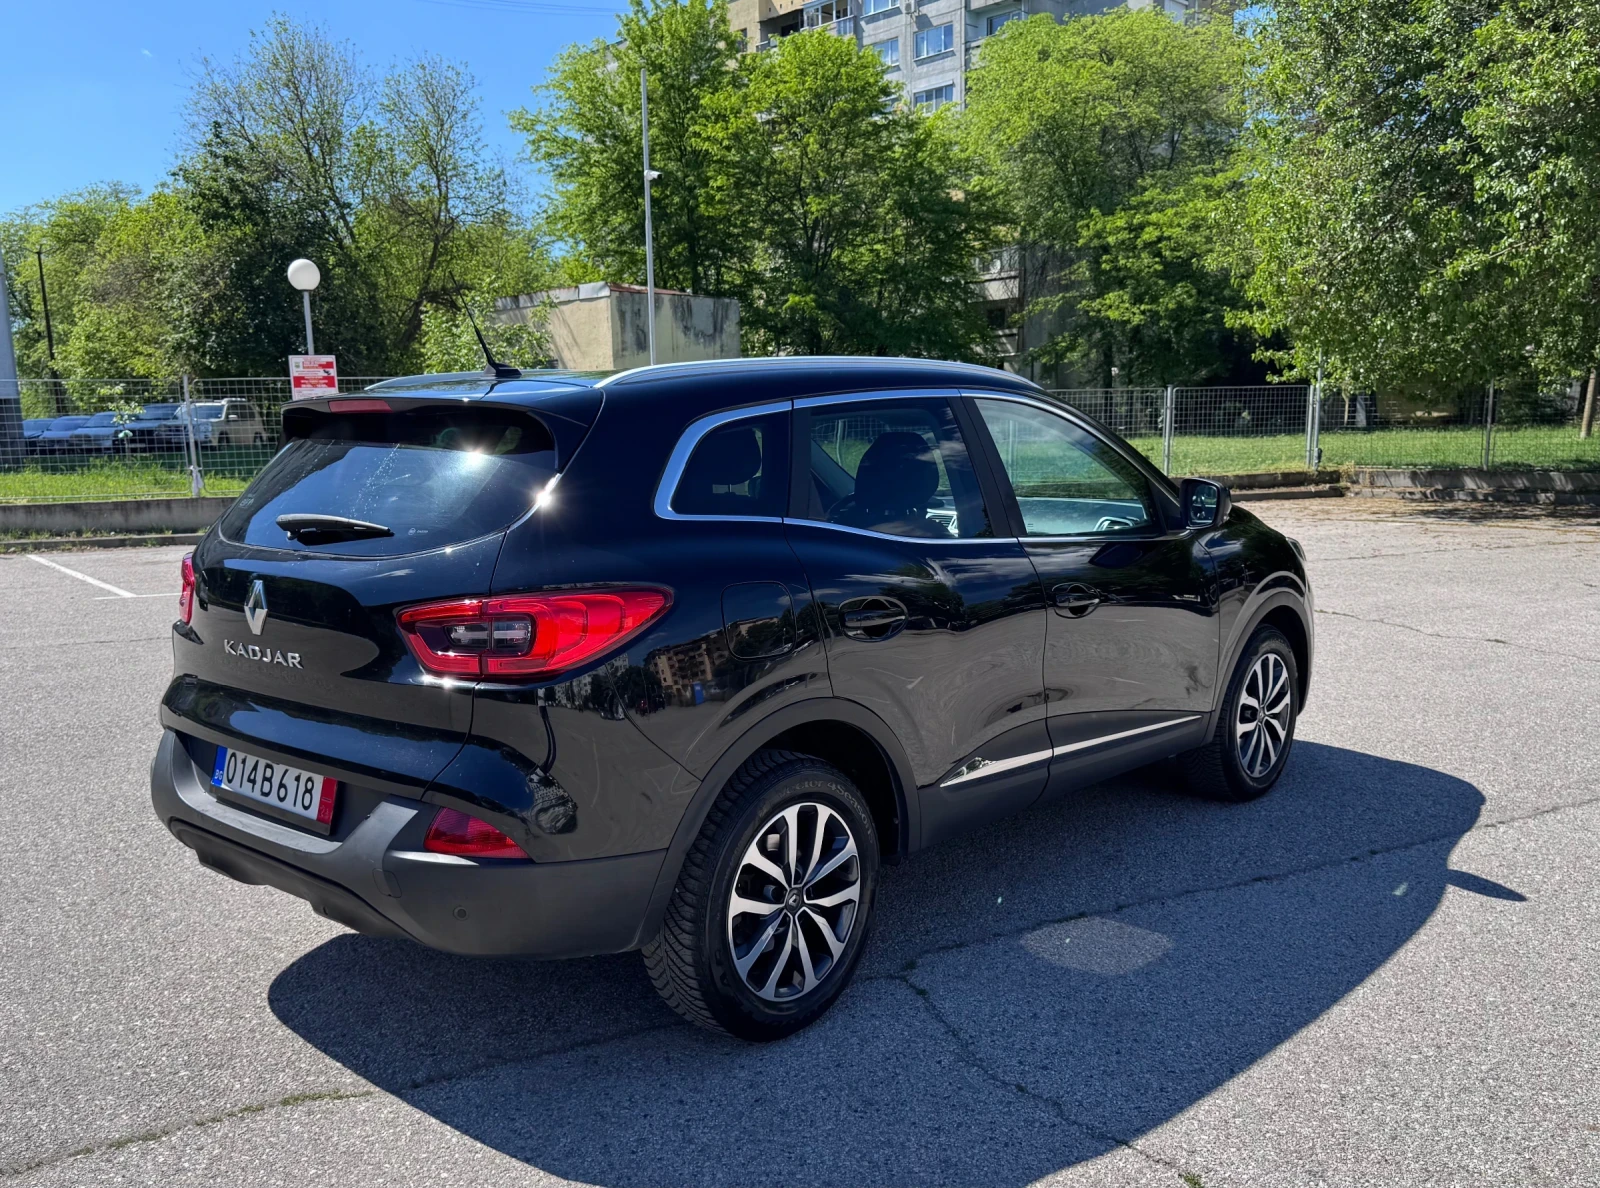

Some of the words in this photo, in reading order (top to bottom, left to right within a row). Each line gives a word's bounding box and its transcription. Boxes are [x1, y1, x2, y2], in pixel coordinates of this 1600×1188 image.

[224, 639, 304, 669] KADJAR
[215, 769, 223, 781] BG
[226, 752, 315, 811] 014B618
